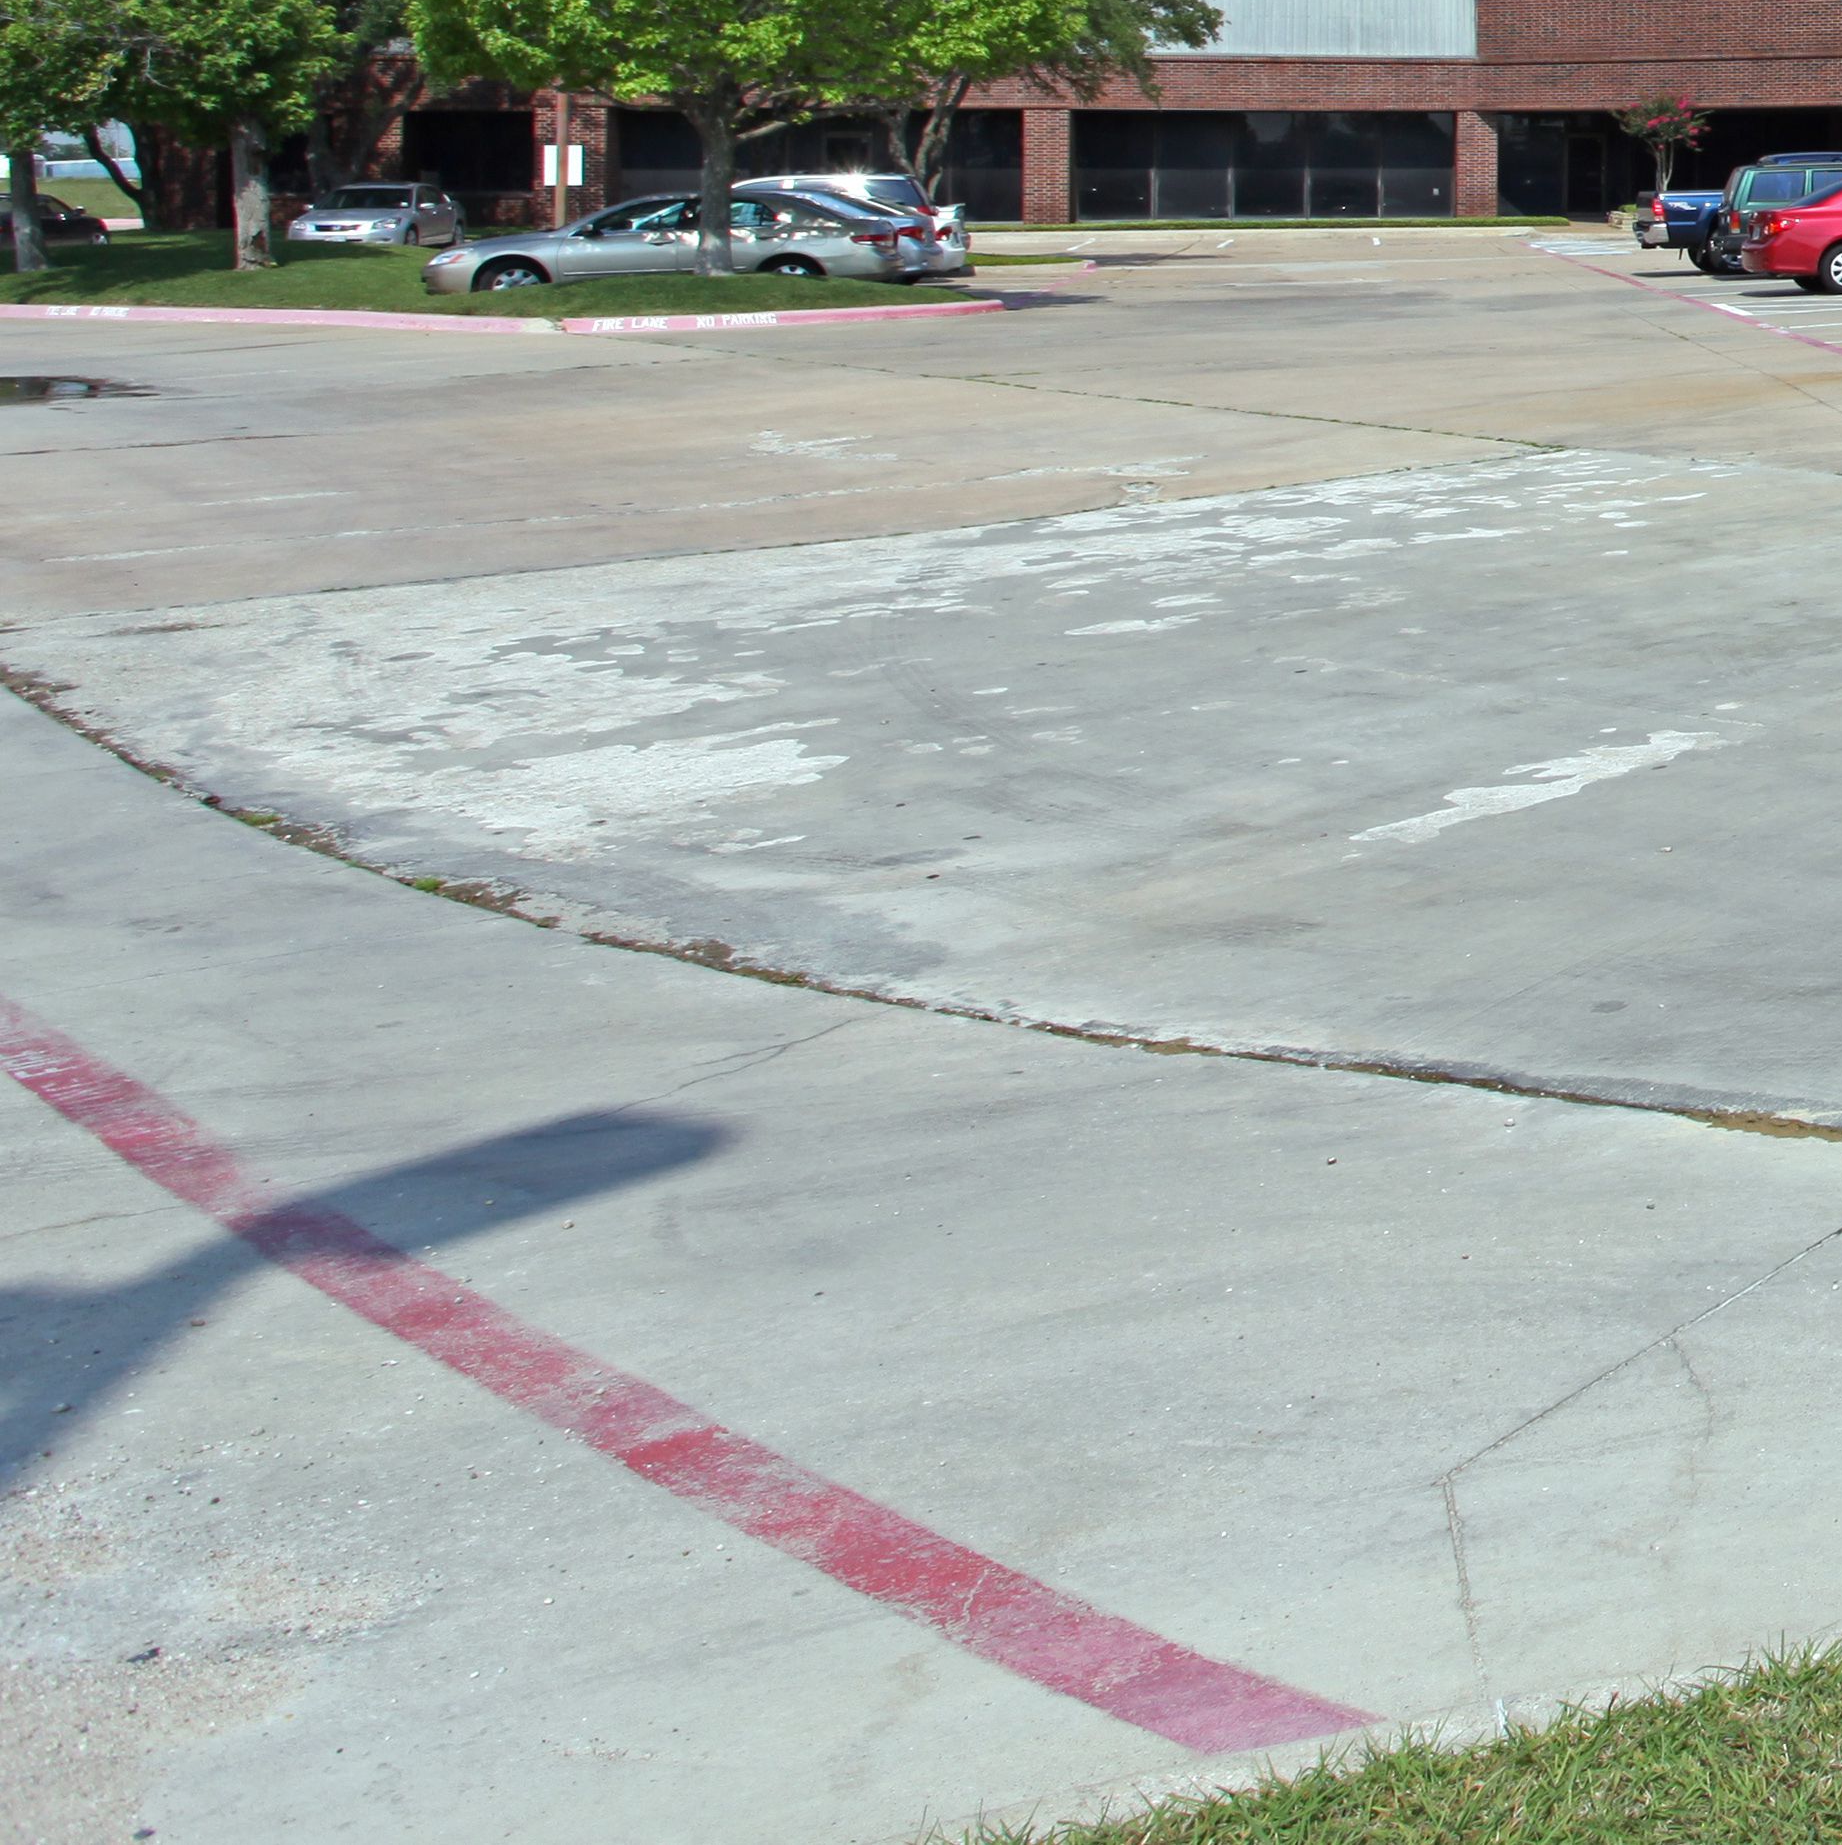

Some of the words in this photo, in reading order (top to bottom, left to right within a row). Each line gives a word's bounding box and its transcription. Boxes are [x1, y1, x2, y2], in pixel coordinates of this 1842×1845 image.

[592, 318, 624, 332] FIRE
[632, 317, 668, 329] LANE
[697, 315, 715, 329] NO
[722, 312, 777, 326] PARKING
